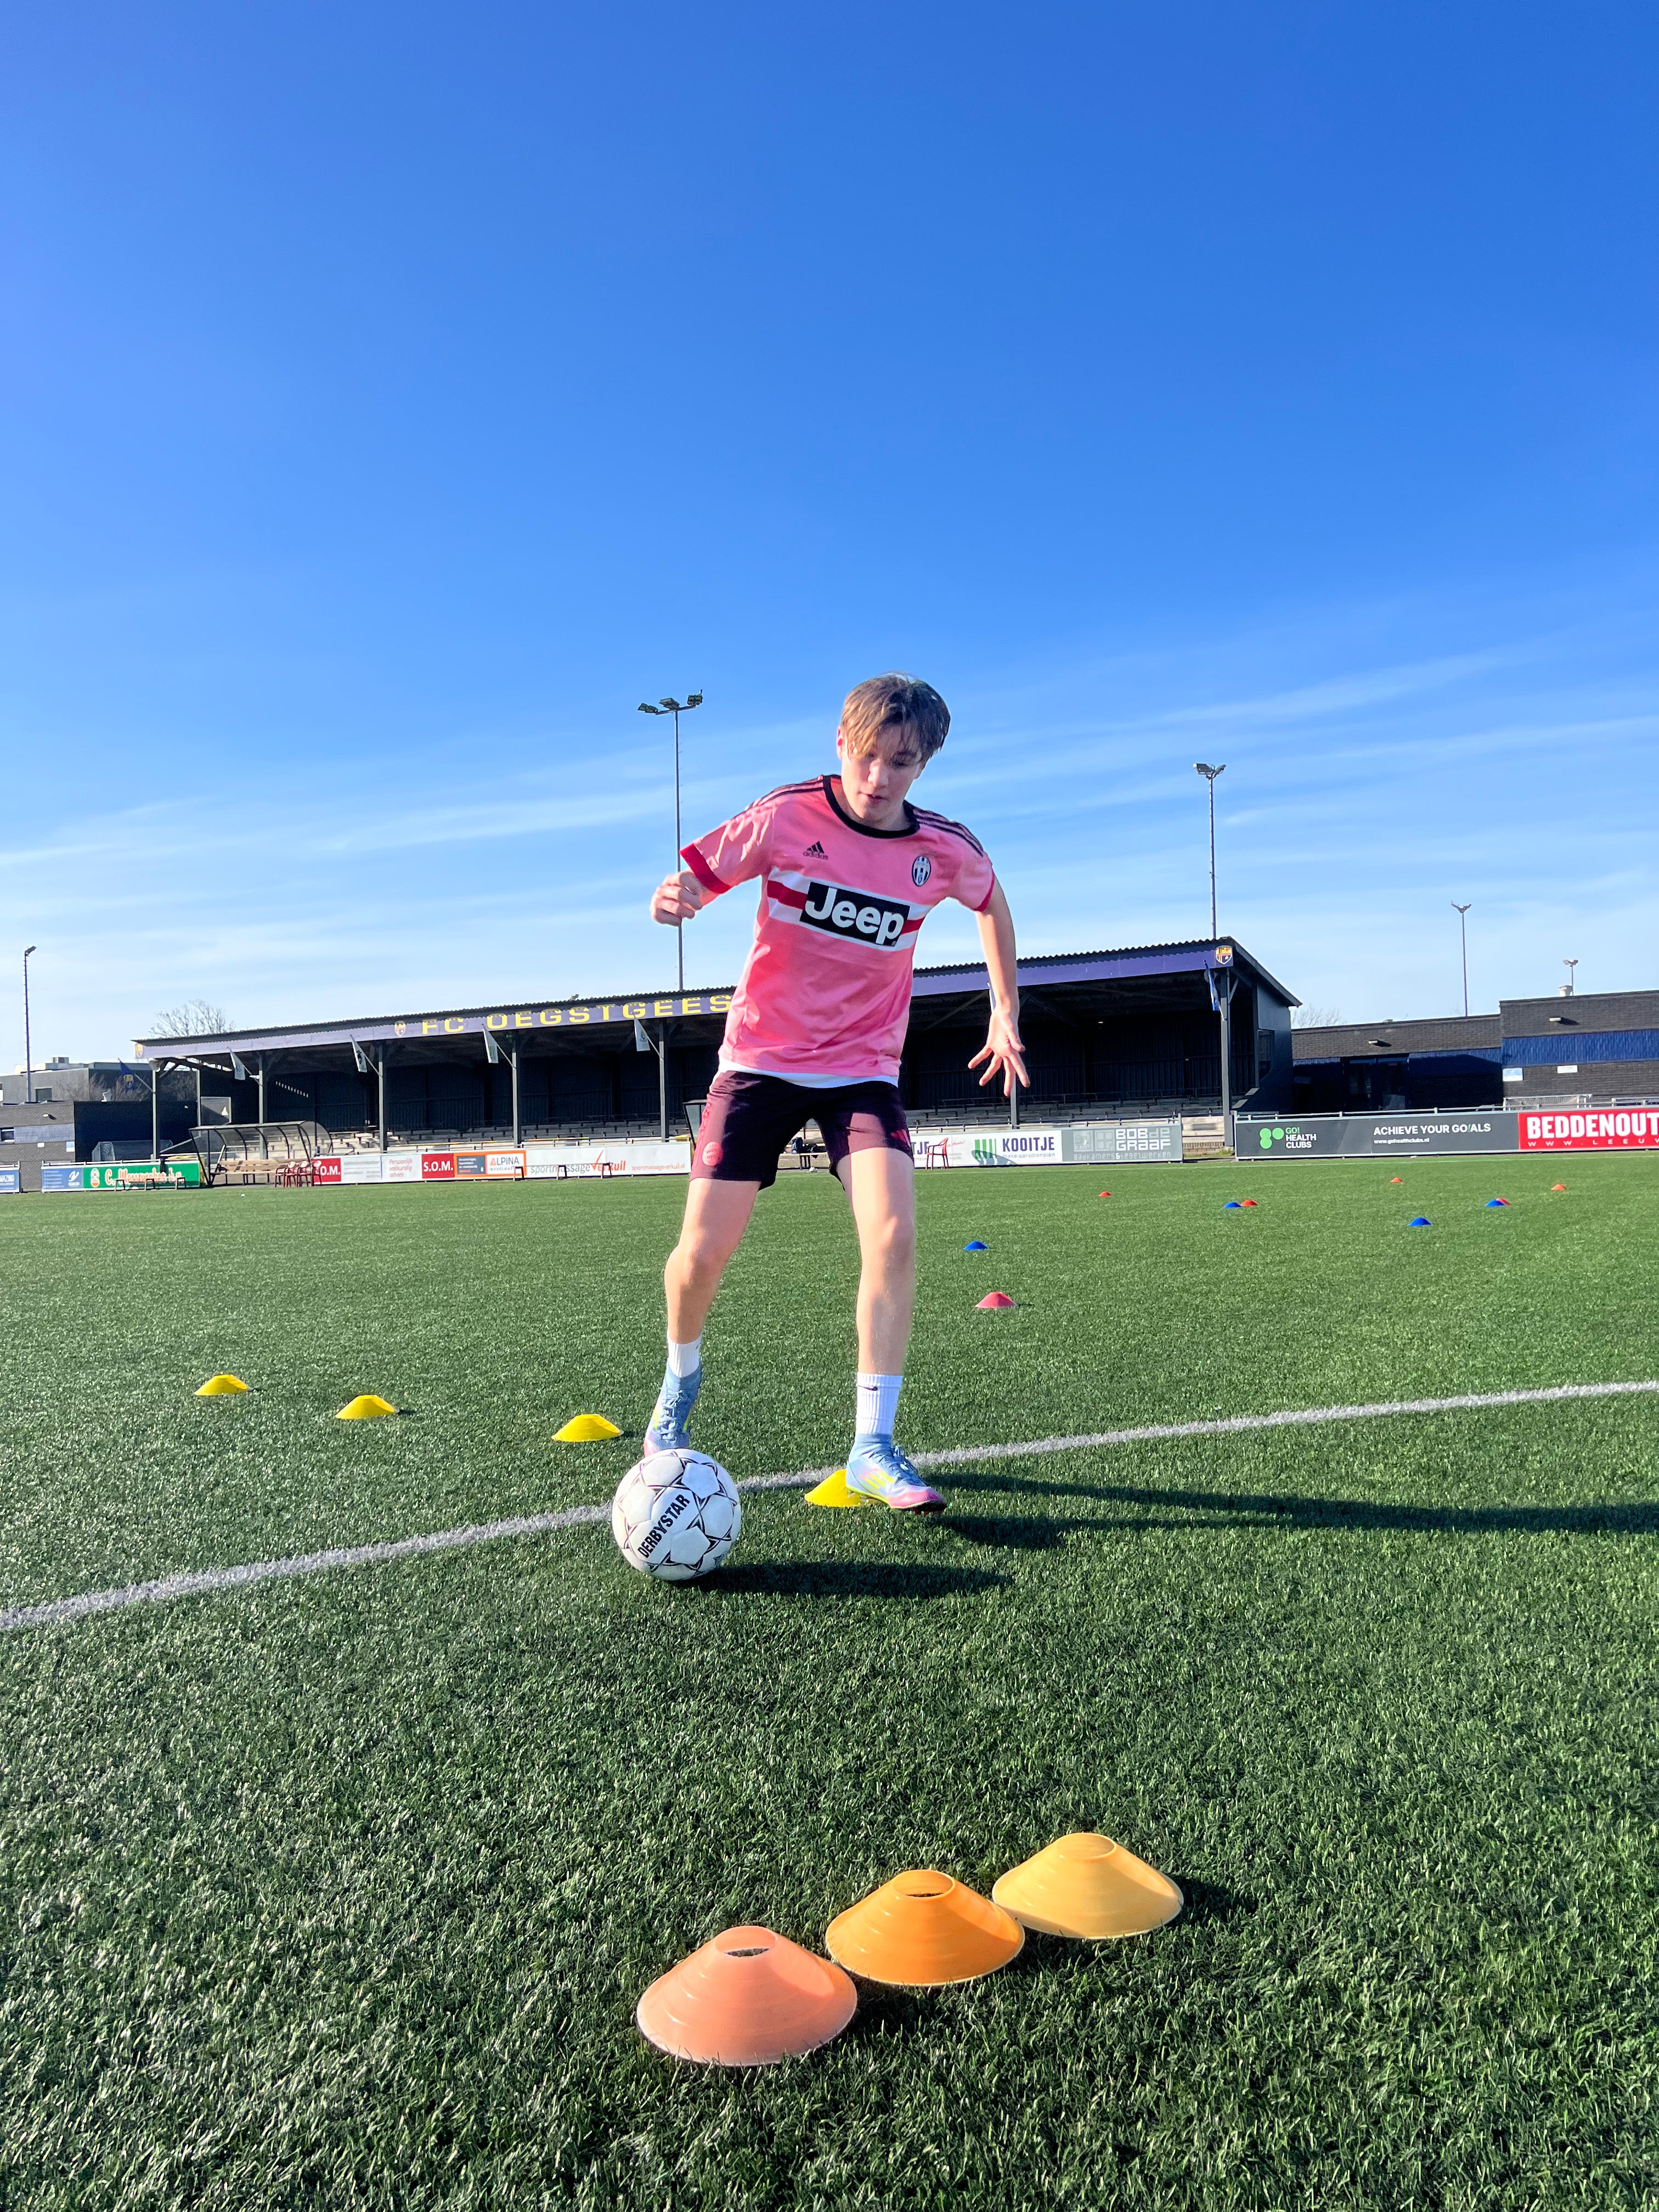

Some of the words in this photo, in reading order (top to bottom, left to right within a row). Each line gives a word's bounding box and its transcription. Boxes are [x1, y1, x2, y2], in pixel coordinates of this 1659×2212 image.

[805, 887, 905, 945] Jeep
[422, 1017, 464, 1035] FC
[1116, 1128, 1148, 1140] BOB
[1285, 1126, 1300, 1135] GO!
[1373, 1126, 1419, 1136] ACHIEVE
[1420, 1125, 1450, 1134] YOUR
[1285, 1133, 1317, 1142] HEALTH
[1002, 1137, 1055, 1152] KOOITJE
[423, 1160, 454, 1172] S.O.M.
[490, 1156, 520, 1166] ALPINA
[637, 1494, 690, 1559] DERBYSTAR
